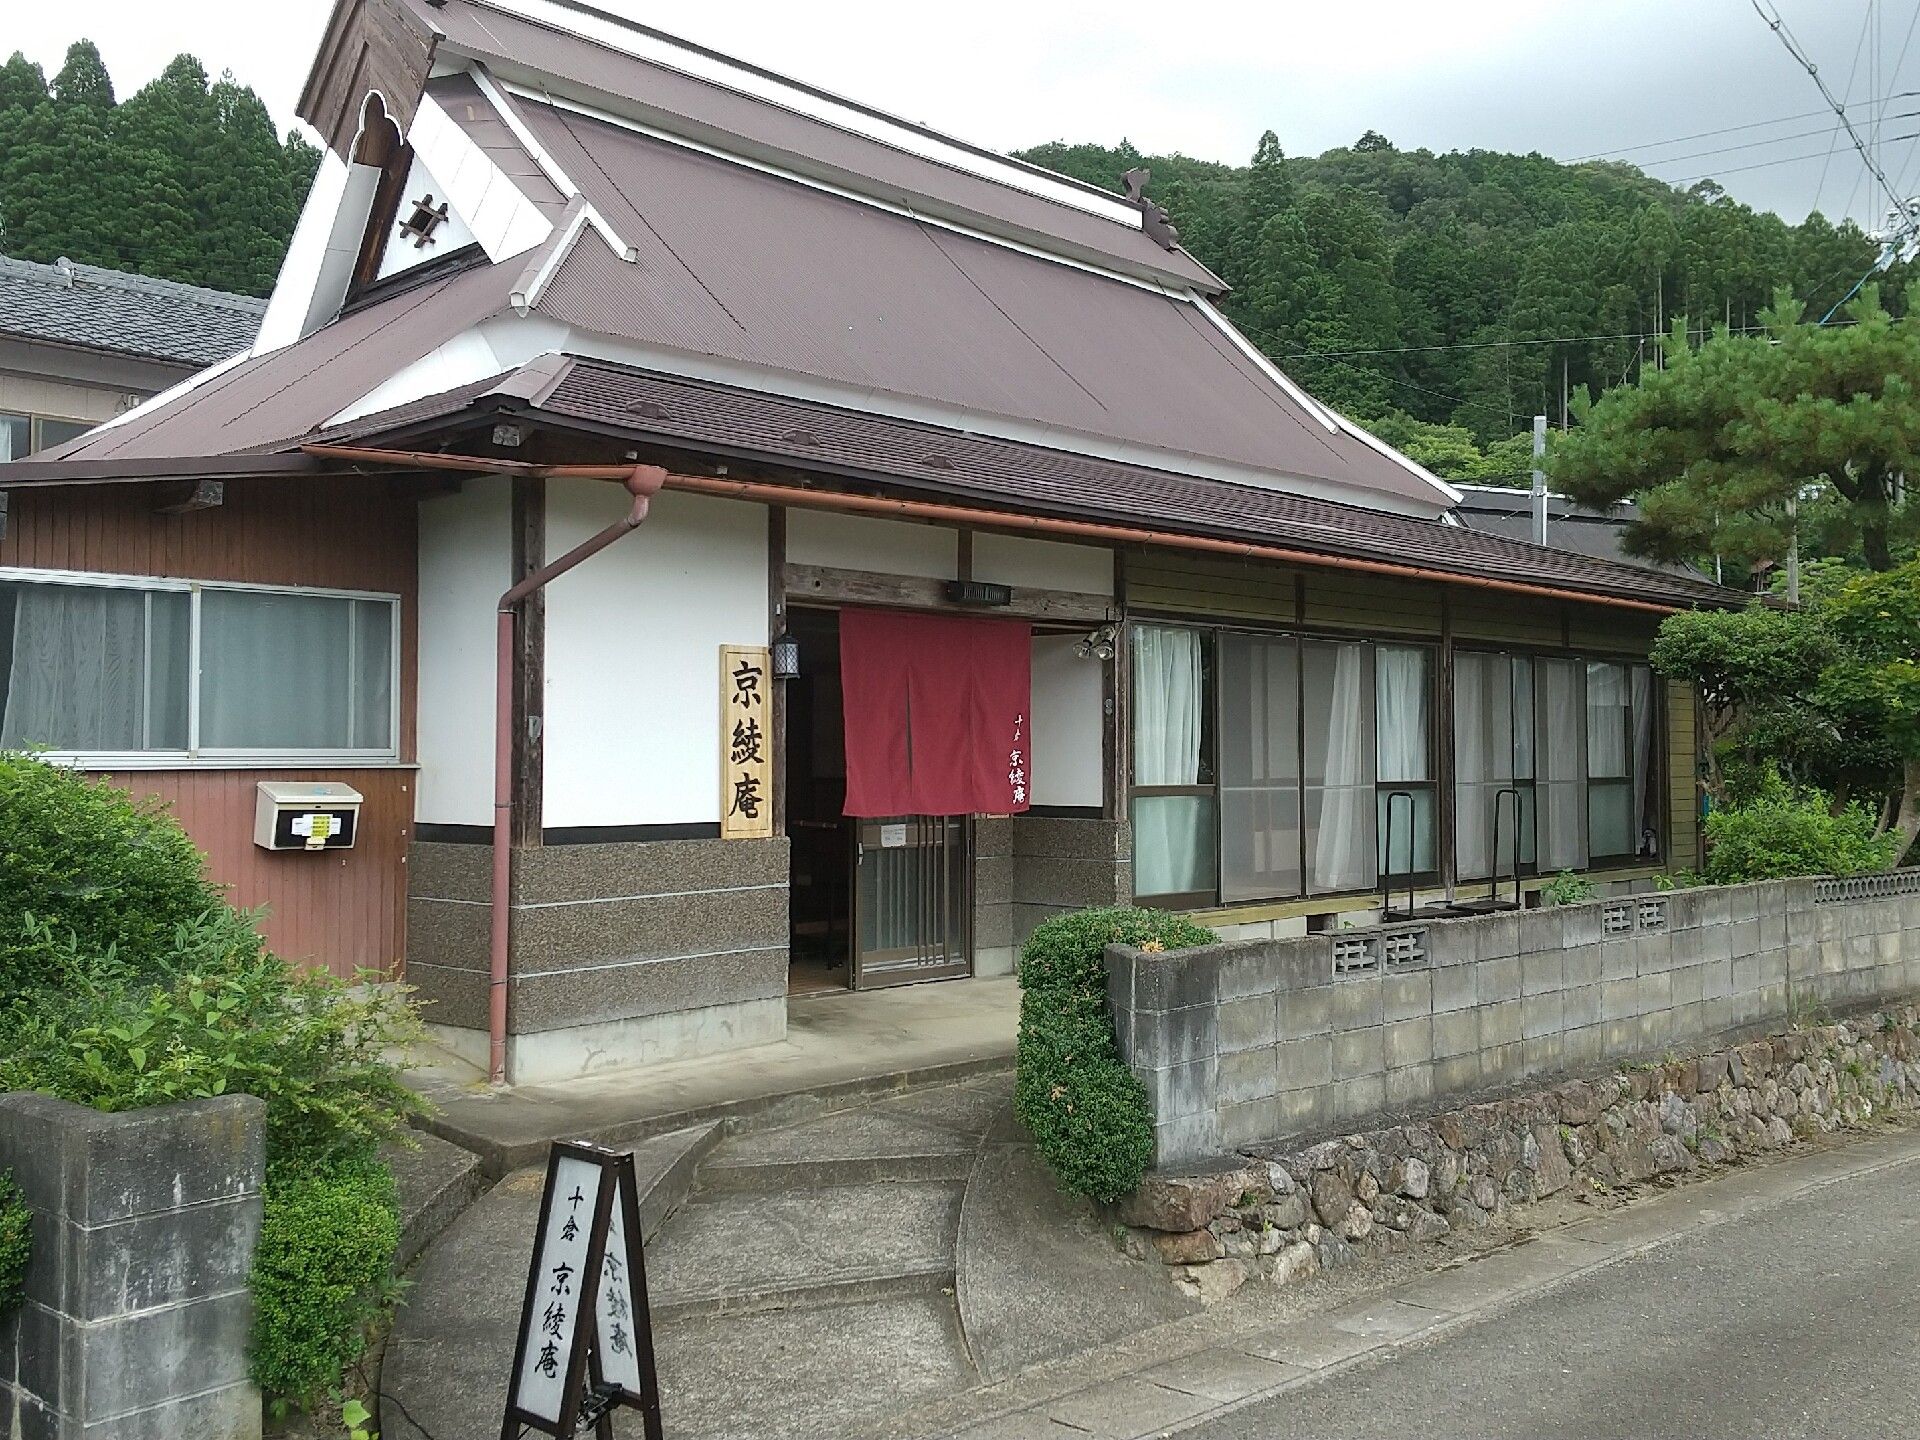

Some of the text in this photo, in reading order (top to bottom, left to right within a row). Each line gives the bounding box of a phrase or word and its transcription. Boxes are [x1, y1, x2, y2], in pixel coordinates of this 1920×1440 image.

[729, 660, 765, 819] 京綾庵
[1009, 749, 1026, 804] 京綾庵
[534, 1186, 584, 1379] 十倉 京綾庵
